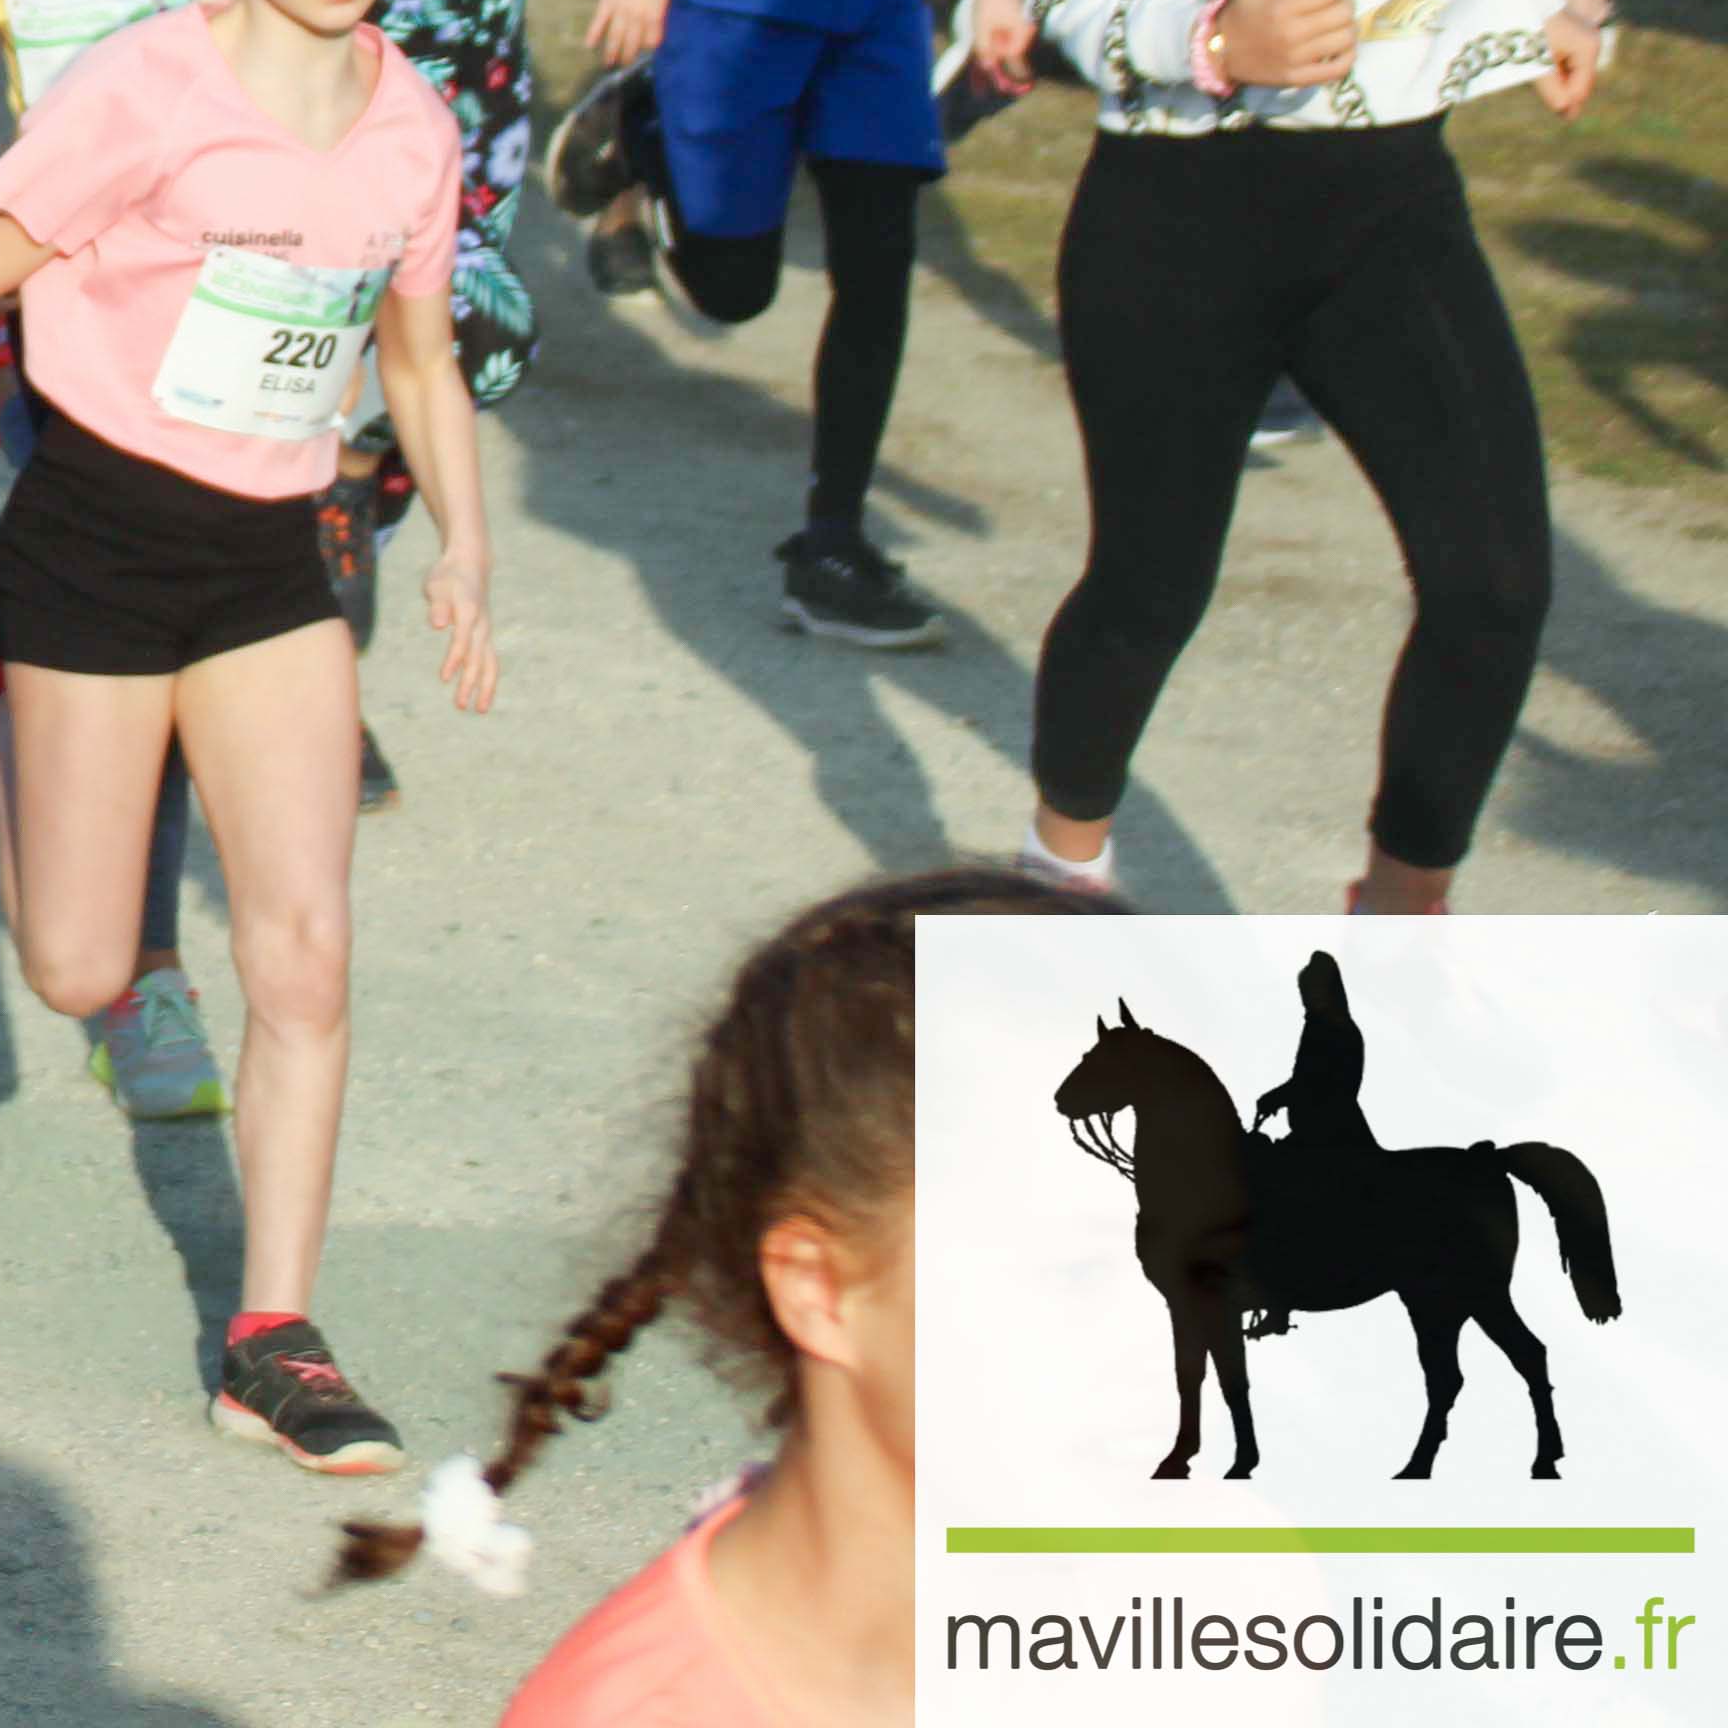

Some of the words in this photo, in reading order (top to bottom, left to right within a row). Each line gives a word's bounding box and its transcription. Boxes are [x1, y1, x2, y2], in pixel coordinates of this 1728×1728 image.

[202, 229, 304, 247] cuisinella
[262, 329, 338, 369] 220
[259, 373, 317, 395] ELISA
